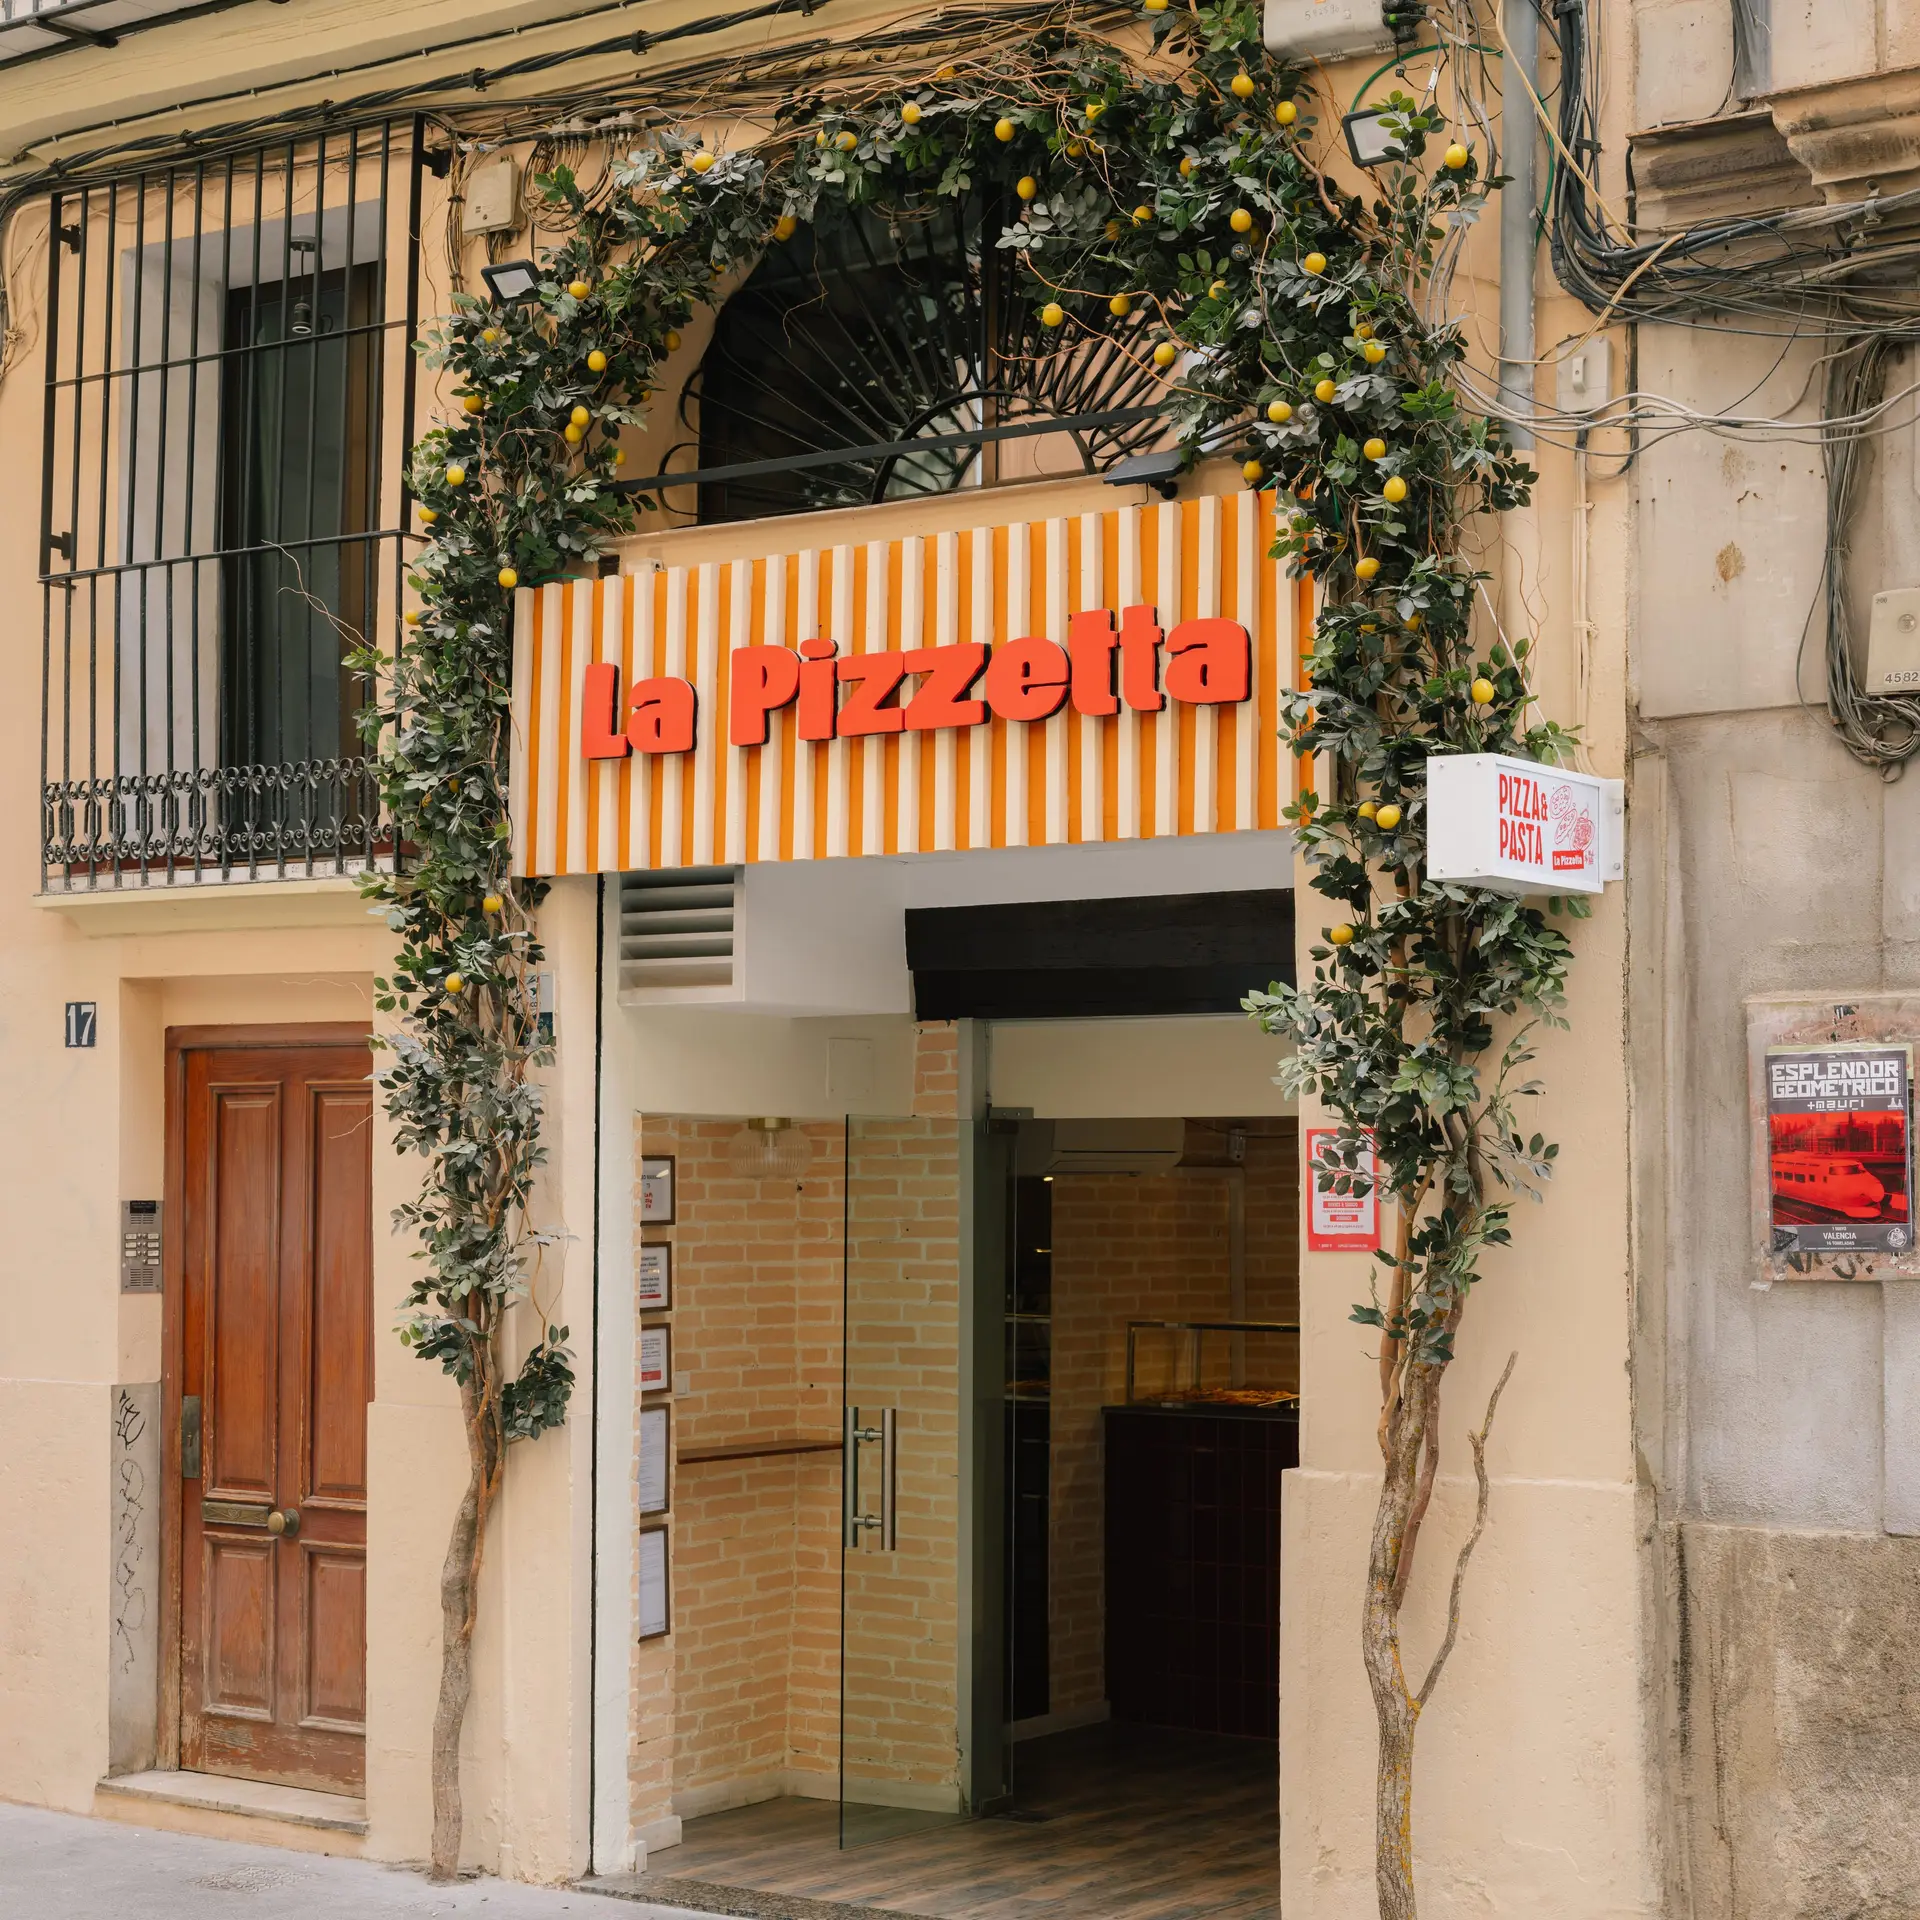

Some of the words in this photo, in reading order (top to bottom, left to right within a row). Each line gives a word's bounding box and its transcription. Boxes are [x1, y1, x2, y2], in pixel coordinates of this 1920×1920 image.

[581, 663, 698, 759] La
[730, 604, 1252, 747] Pizzetta
[1885, 672, 1919, 683] 4582
[1499, 818, 1544, 865] PASTA
[67, 1004, 95, 1046] 17
[1771, 1060, 1899, 1081] ESPLENDOR
[1772, 1077, 1899, 1099] GEOMETRICO
[1822, 1232, 1857, 1240] VALENCIA
